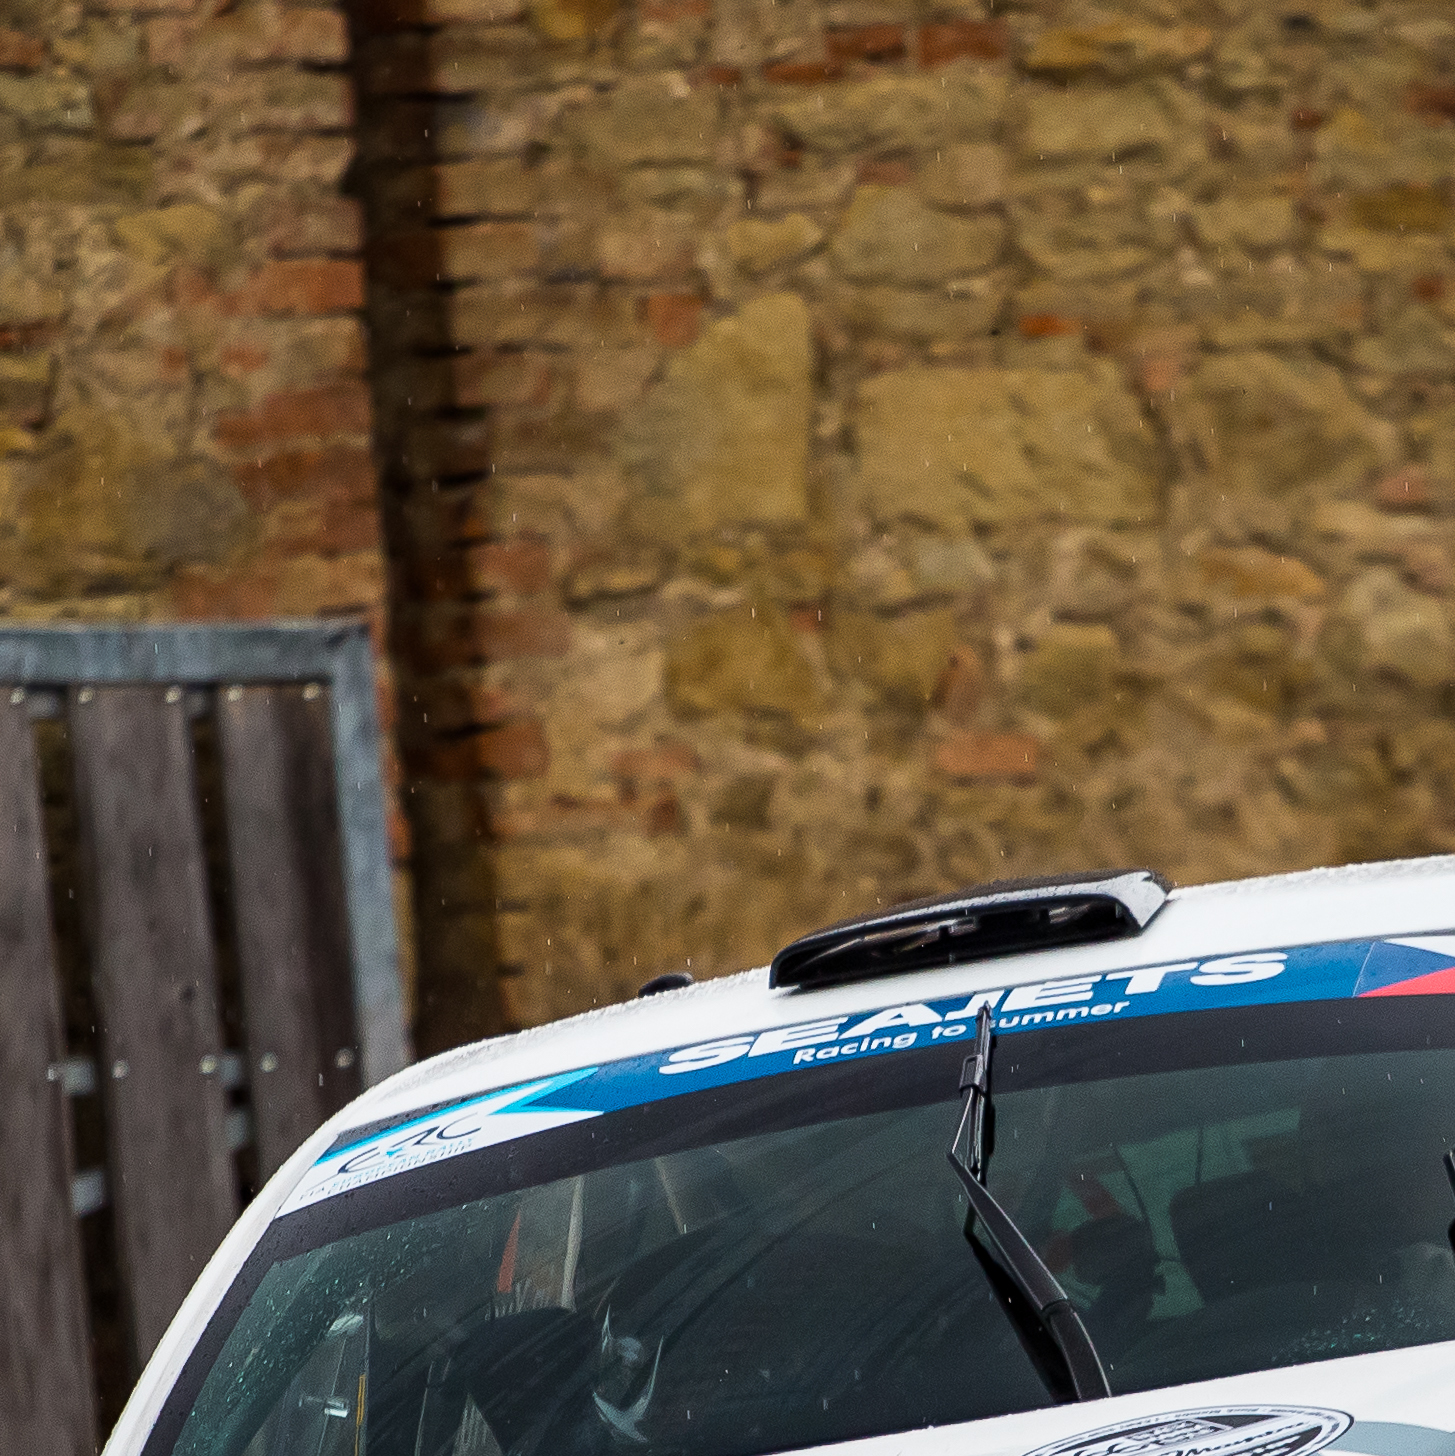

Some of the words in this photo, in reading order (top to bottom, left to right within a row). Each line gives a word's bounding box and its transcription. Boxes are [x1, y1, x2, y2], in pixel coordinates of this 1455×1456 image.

[658, 951, 1289, 1074] SEAJETS
[793, 1031, 918, 1064] Racing
[931, 1023, 968, 1041] to
[989, 1000, 1131, 1029] ummer
